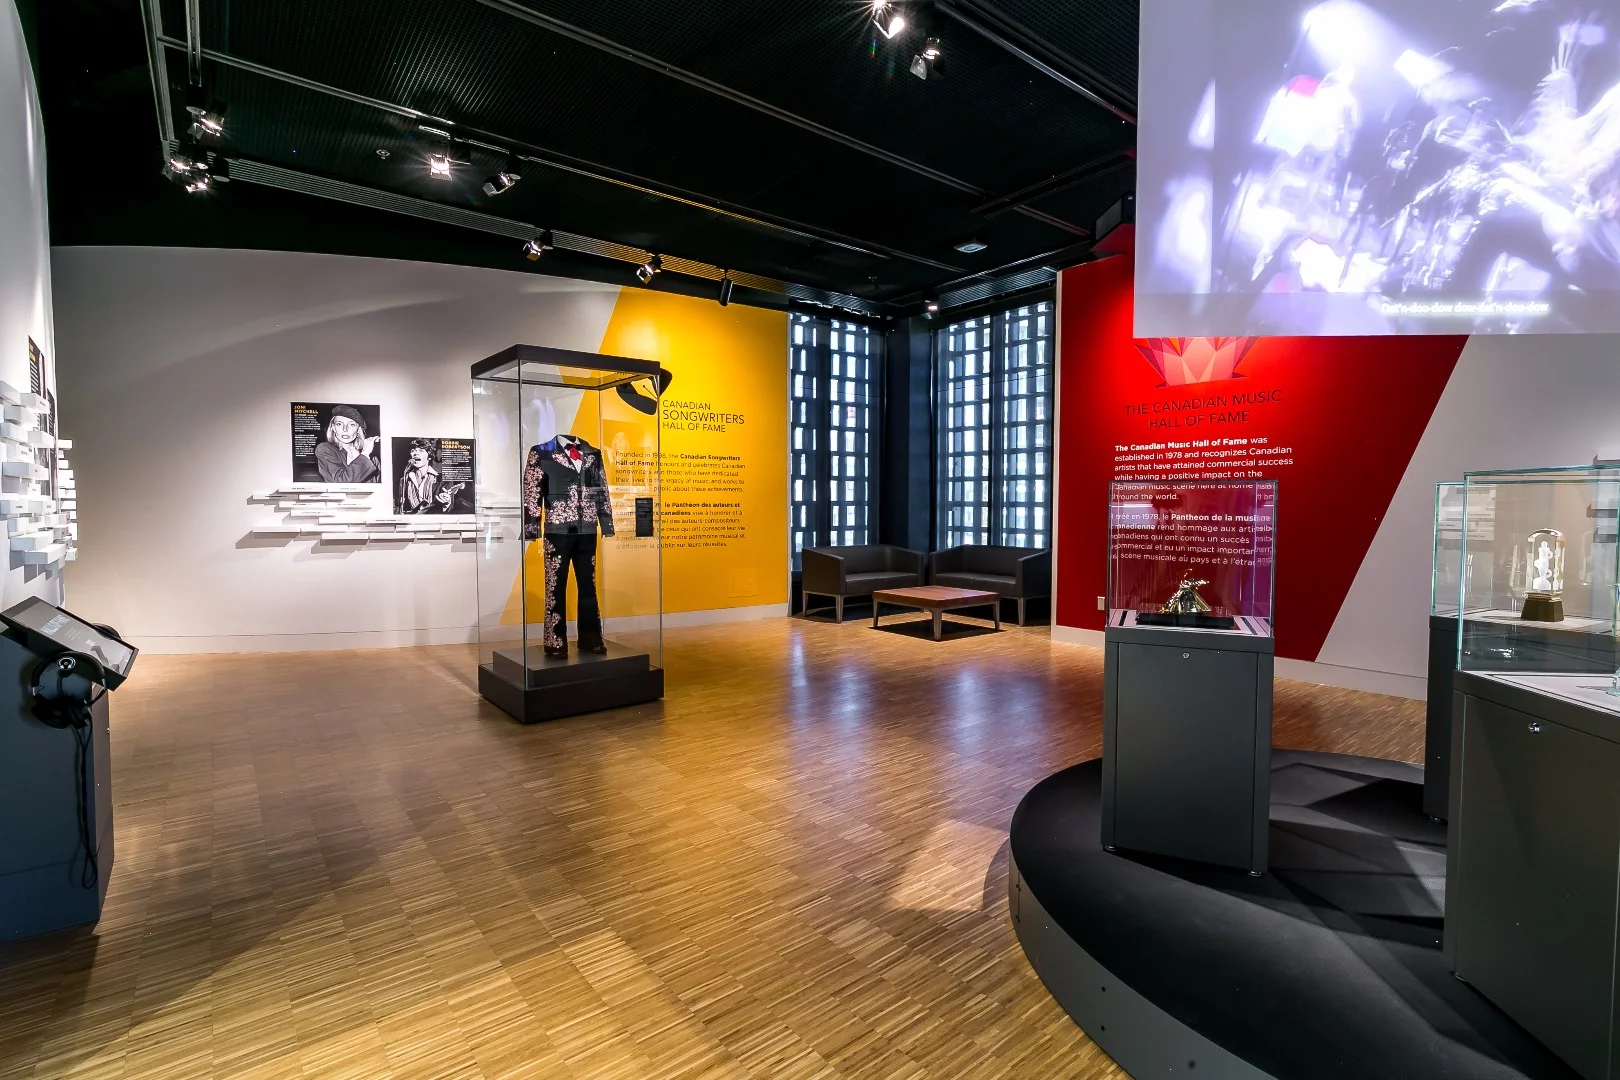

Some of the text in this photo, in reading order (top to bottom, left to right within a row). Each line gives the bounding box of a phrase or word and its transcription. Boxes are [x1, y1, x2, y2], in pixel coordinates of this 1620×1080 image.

[662, 399, 711, 411] CANADIAN
[1125, 389, 1283, 416] THE CANADIAN MUSIC
[662, 409, 745, 425] SONGWRITERS
[1149, 410, 1251, 429] HALL OF FAME
[662, 421, 726, 433] HALL OF FAME
[1114, 444, 1129, 452] The
[1130, 443, 1165, 451] Canadian
[1167, 441, 1191, 449] Music
[1192, 439, 1209, 447] Hall
[1211, 438, 1221, 446] of
[1222, 438, 1248, 446] Fame
[708, 454, 741, 462] Songwriters
[1114, 446, 1292, 461] established in 1978 and recognizes Canadian
[1137, 463, 1151, 471] that
[1153, 462, 1171, 470] have
[1172, 461, 1205, 469] attained
[1206, 458, 1255, 468] commercial
[1258, 458, 1294, 466] success
[1114, 473, 1133, 481] while
[1134, 473, 1160, 481] having
[1168, 472, 1200, 481] positive
[1201, 471, 1231, 480] impact
[1247, 469, 1263, 478] the
[1141, 493, 1154, 501] the
[1154, 492, 1179, 501] world.
[1161, 513, 1170, 521] le
[1211, 513, 1223, 521] de
[1224, 513, 1234, 521] la
[1157, 523, 1175, 531] rend
[1176, 523, 1219, 533] hommage
[1150, 534, 1164, 542] qui
[1179, 534, 1205, 542] connu
[1207, 535, 1219, 543] un
[1154, 543, 1163, 551] et
[1187, 544, 1215, 553] impact
[1216, 545, 1258, 555] importan
[1143, 553, 1177, 562] musicale
[1190, 556, 1210, 565] pays
[1211, 556, 1221, 564] et
